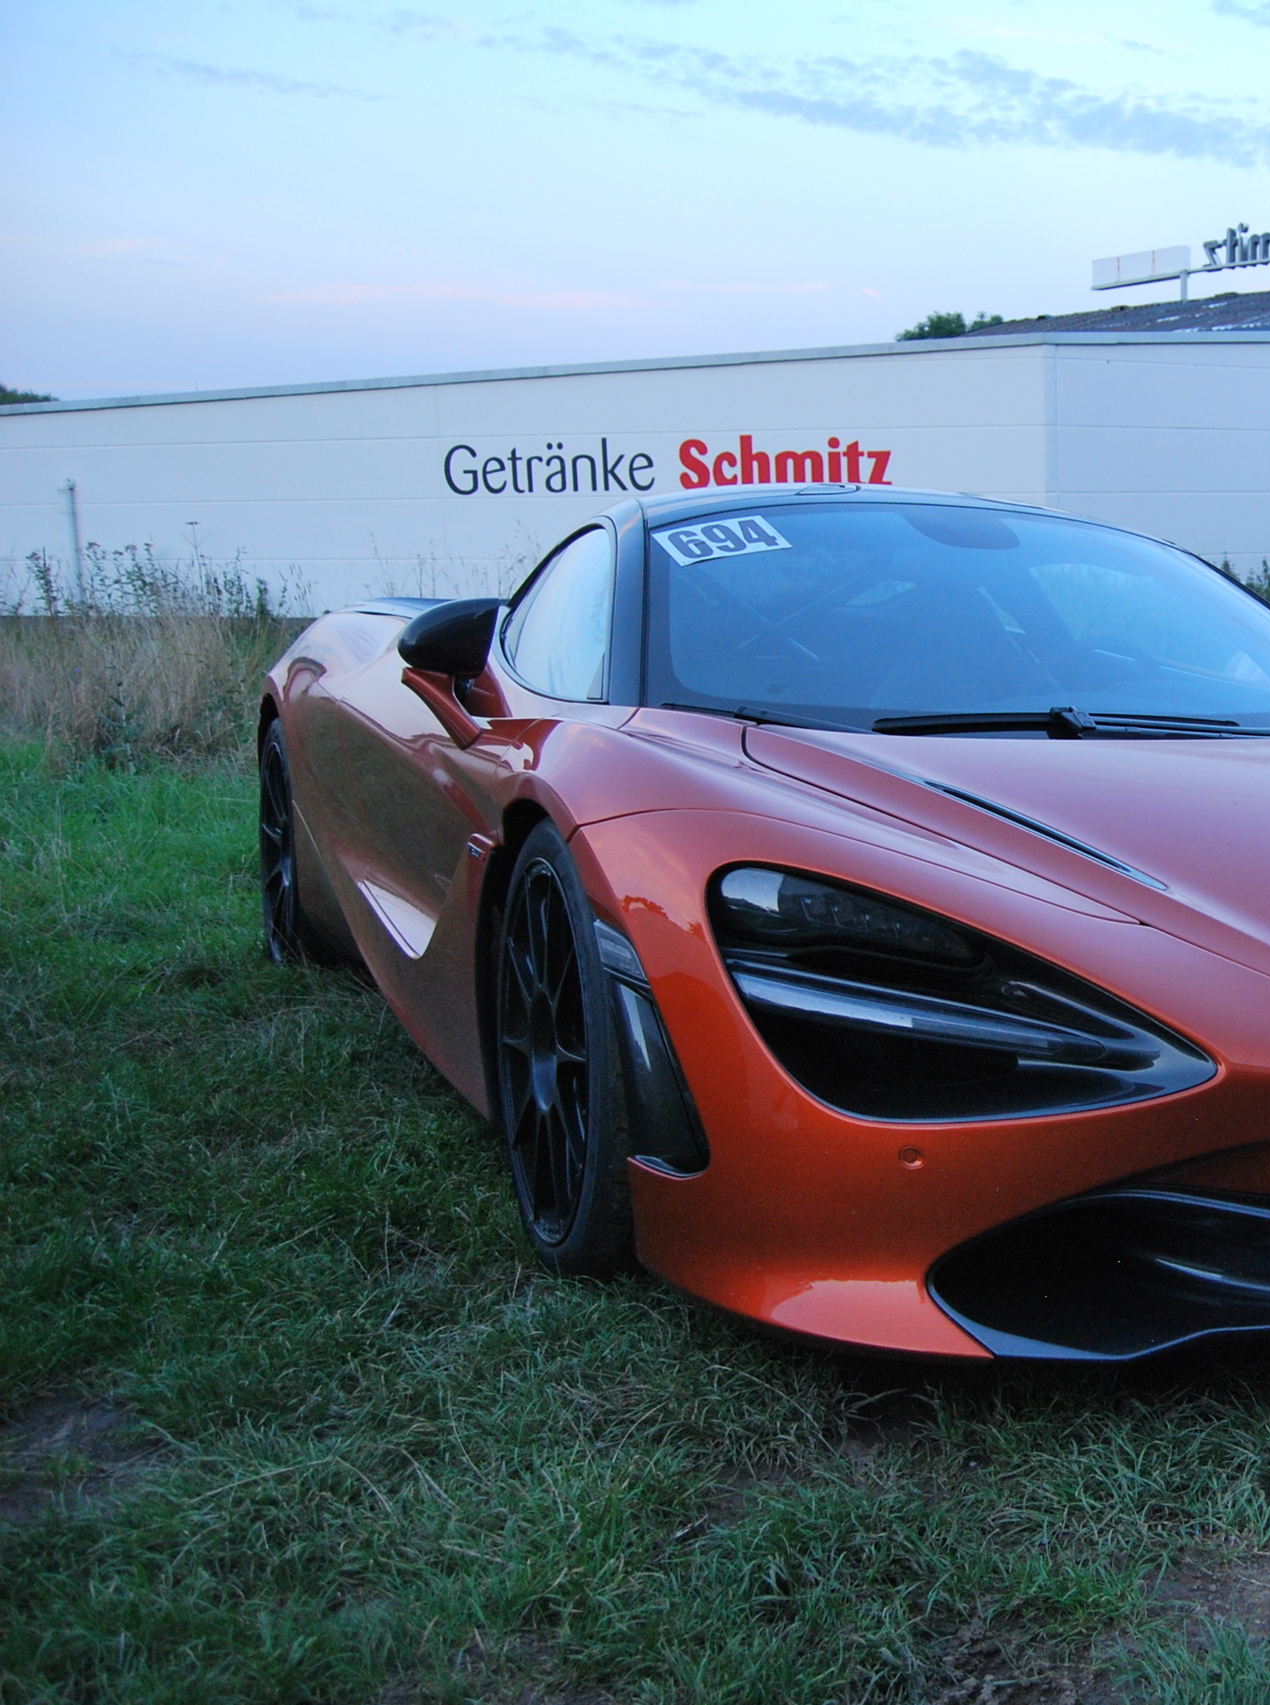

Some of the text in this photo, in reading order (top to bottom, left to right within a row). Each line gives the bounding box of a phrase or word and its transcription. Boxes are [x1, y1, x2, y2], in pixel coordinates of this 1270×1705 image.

[443, 434, 893, 496] Getränke Schmitz
[667, 517, 780, 559] 694
